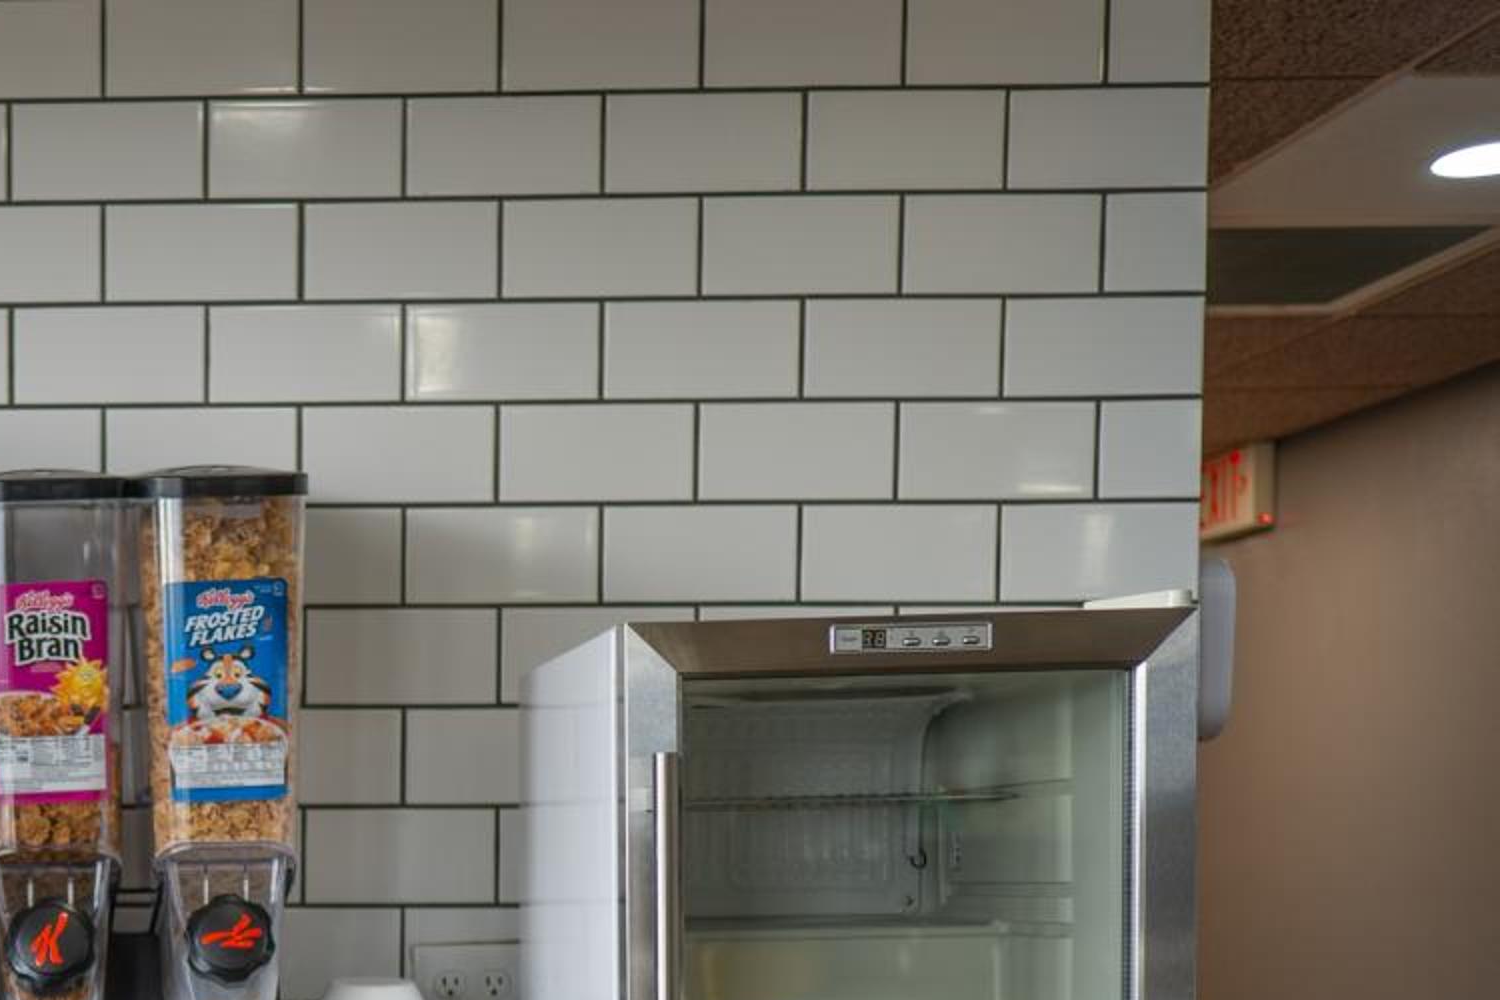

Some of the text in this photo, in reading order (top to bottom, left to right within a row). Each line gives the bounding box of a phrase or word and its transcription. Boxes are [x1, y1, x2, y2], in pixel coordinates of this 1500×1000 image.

[7, 611, 89, 642] Raisin
[184, 606, 264, 633] FROSTED
[189, 622, 258, 647] FLAKES
[17, 637, 80, 662] Bran
